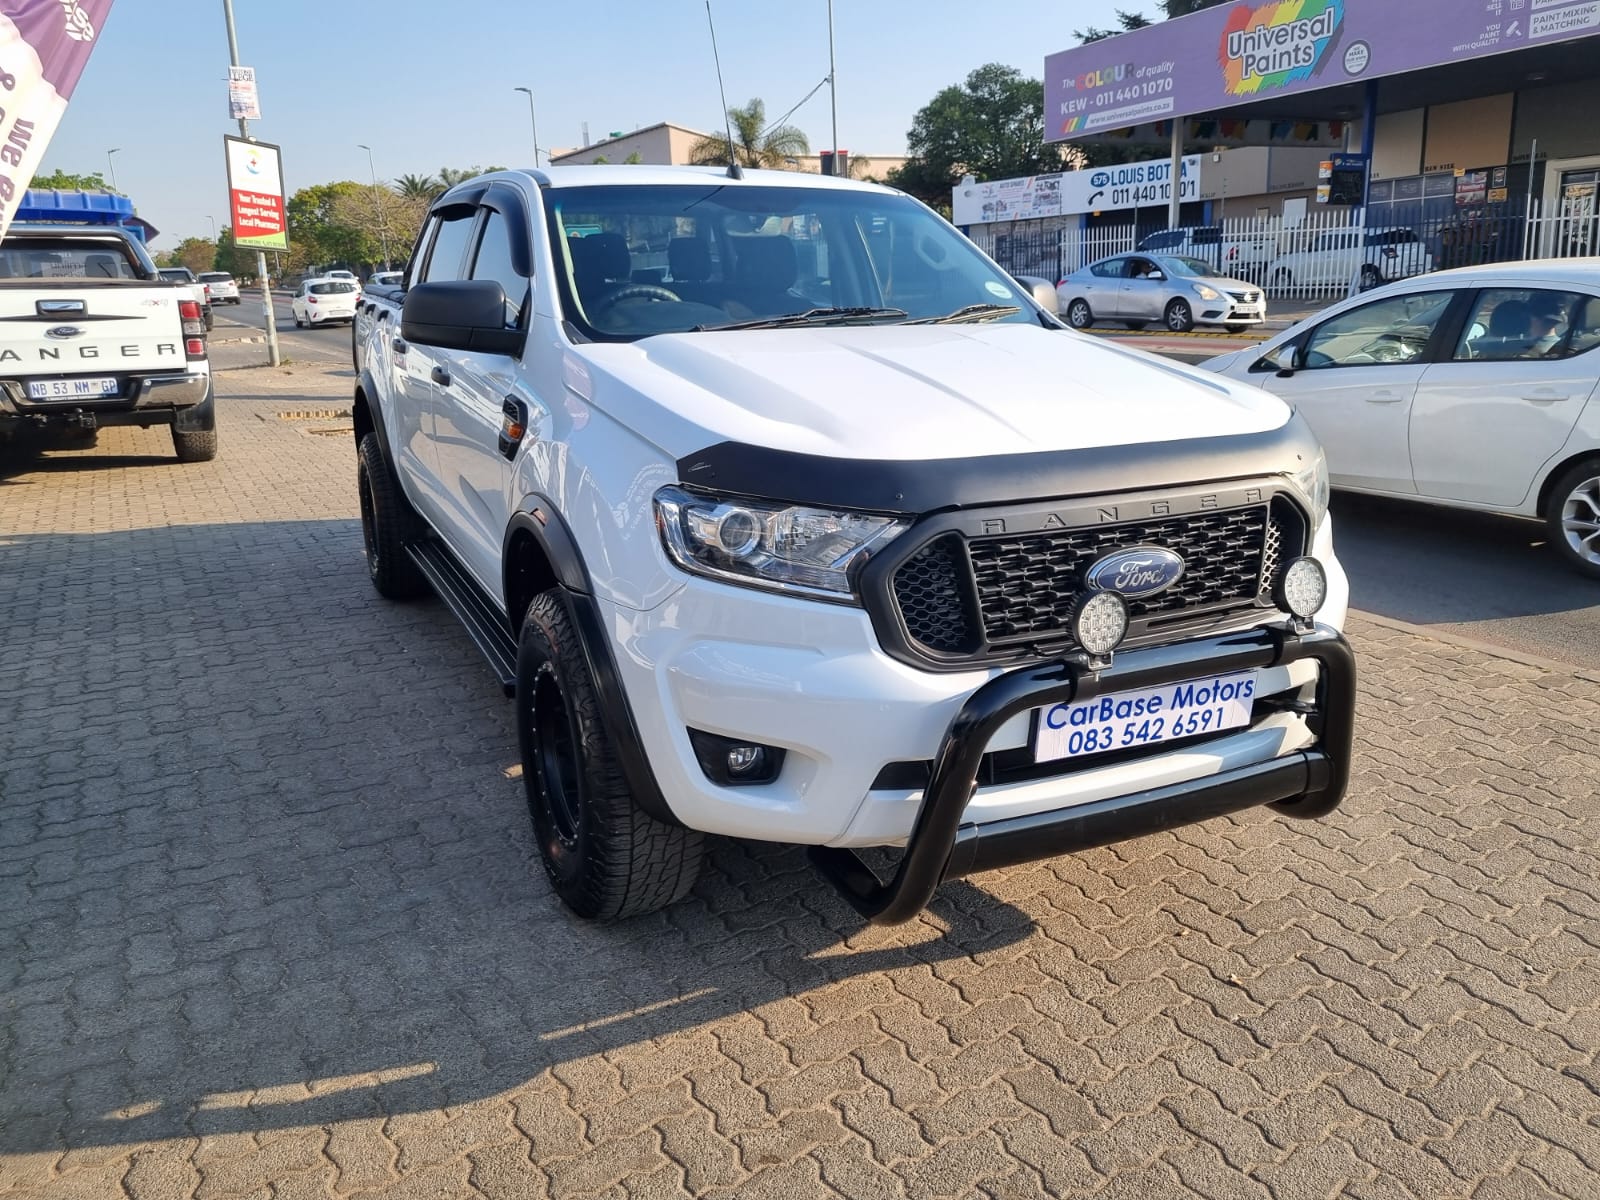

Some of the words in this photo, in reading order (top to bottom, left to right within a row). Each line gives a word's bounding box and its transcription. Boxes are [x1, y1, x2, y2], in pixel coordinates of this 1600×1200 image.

[1486, 23, 1501, 32] YOU
[1534, 12, 1561, 25] PAINT
[1562, 5, 1597, 18] MIXING
[1540, 16, 1590, 33] MATCHING
[1229, 9, 1332, 57] Universal
[1471, 37, 1500, 49] QUALITY
[1479, 30, 1500, 41] PAINT
[1244, 43, 1312, 77] Paints
[1063, 79, 1075, 89] The
[1076, 62, 1135, 92] COLOUR
[1136, 66, 1145, 78] of
[1146, 61, 1175, 78] quality
[1061, 97, 1087, 115] KEW
[1096, 91, 1113, 106] 011
[1116, 84, 1140, 101] 440
[1142, 77, 1173, 97] 1070
[1111, 166, 1144, 187] LOUIS
[1147, 161, 1187, 182] BOTA
[1112, 188, 1130, 205] 011
[1133, 184, 1157, 202] 440
[32, 383, 47, 396] NB
[53, 382, 68, 395] 53
[101, 380, 116, 393] GP
[980, 487, 1262, 535] RANGER
[1114, 559, 1166, 589] Ford
[1046, 693, 1163, 730] CarBase
[1170, 678, 1254, 711] Motors
[1068, 726, 1113, 754] 083
[1121, 717, 1165, 746] 542
[1171, 706, 1224, 737] 6591
